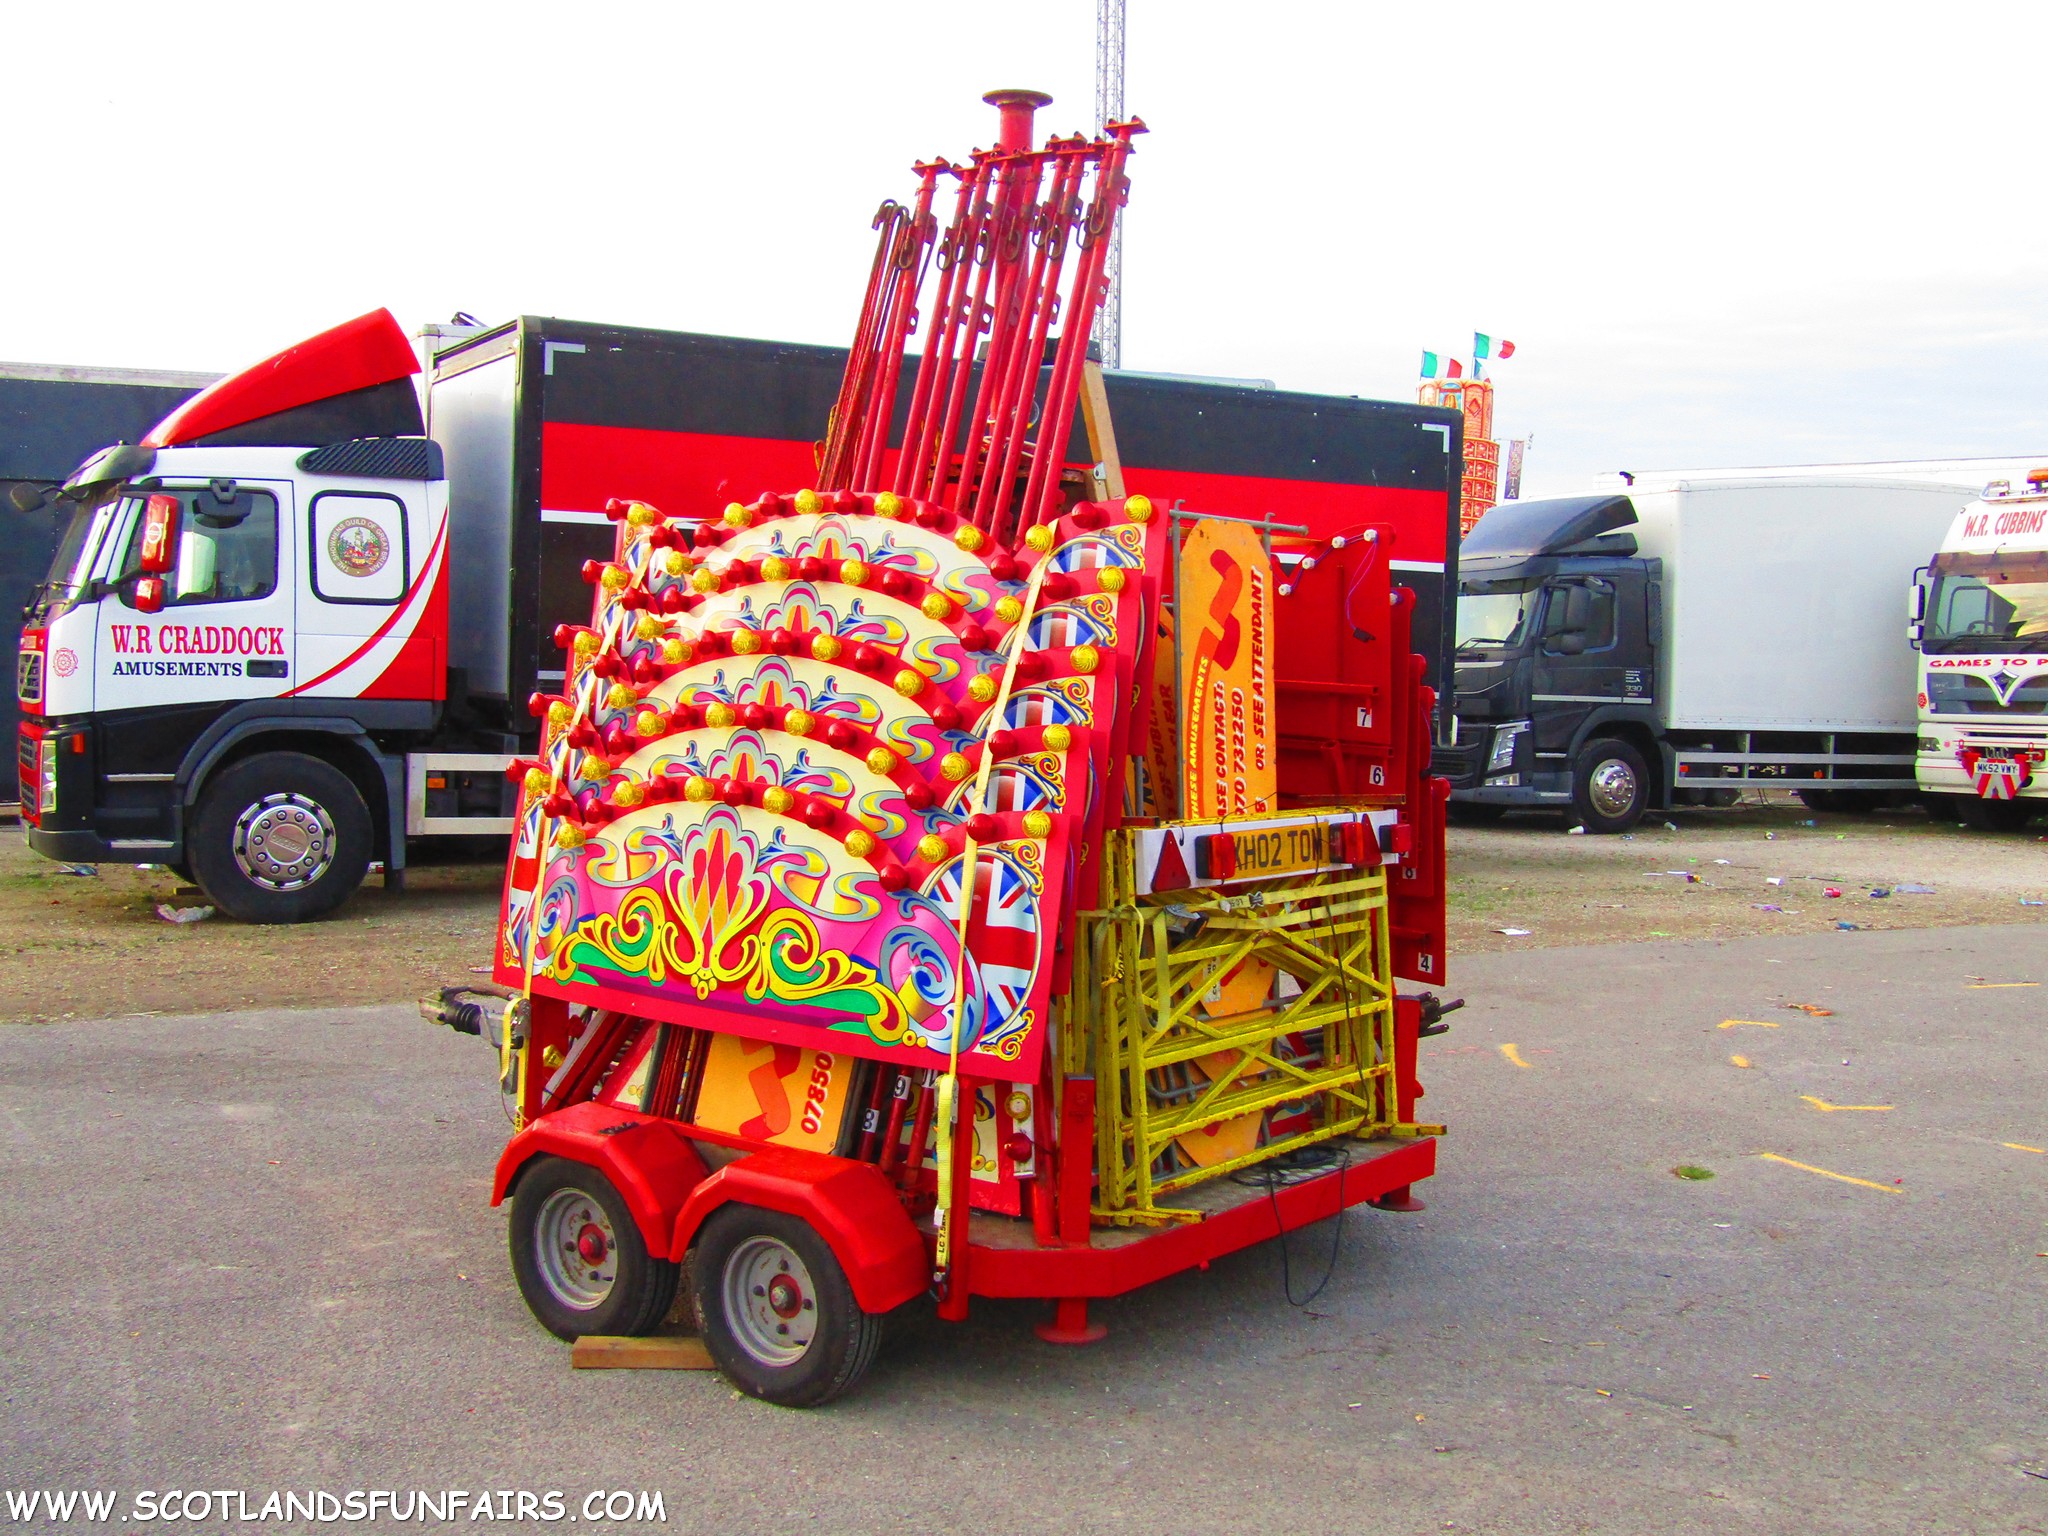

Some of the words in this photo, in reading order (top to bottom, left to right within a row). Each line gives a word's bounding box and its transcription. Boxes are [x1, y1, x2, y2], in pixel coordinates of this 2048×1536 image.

[345, 519, 367, 527] GUILD
[1963, 514, 1988, 537] W.R.
[1995, 510, 2048, 535] CUBBINS
[159, 625, 284, 655] CRADDOCK
[1250, 566, 1265, 696] ATTENDANT
[112, 661, 242, 677] AMUSEMENTS
[1929, 659, 1992, 668] GAMES
[2000, 658, 2028, 666] TO
[1188, 656, 1209, 769] AMUSEMENTS
[1252, 695, 1266, 739] SEE
[1231, 688, 1246, 773] 732250
[1255, 743, 1266, 771] OR
[1977, 763, 1999, 773] MK52
[1372, 766, 1382, 785] 6
[1189, 770, 1200, 818] THESE
[1420, 956, 1430, 972] 4
[800, 1050, 835, 1135] 07850
[893, 1075, 907, 1098] 9
[862, 1109, 875, 1130] 8
